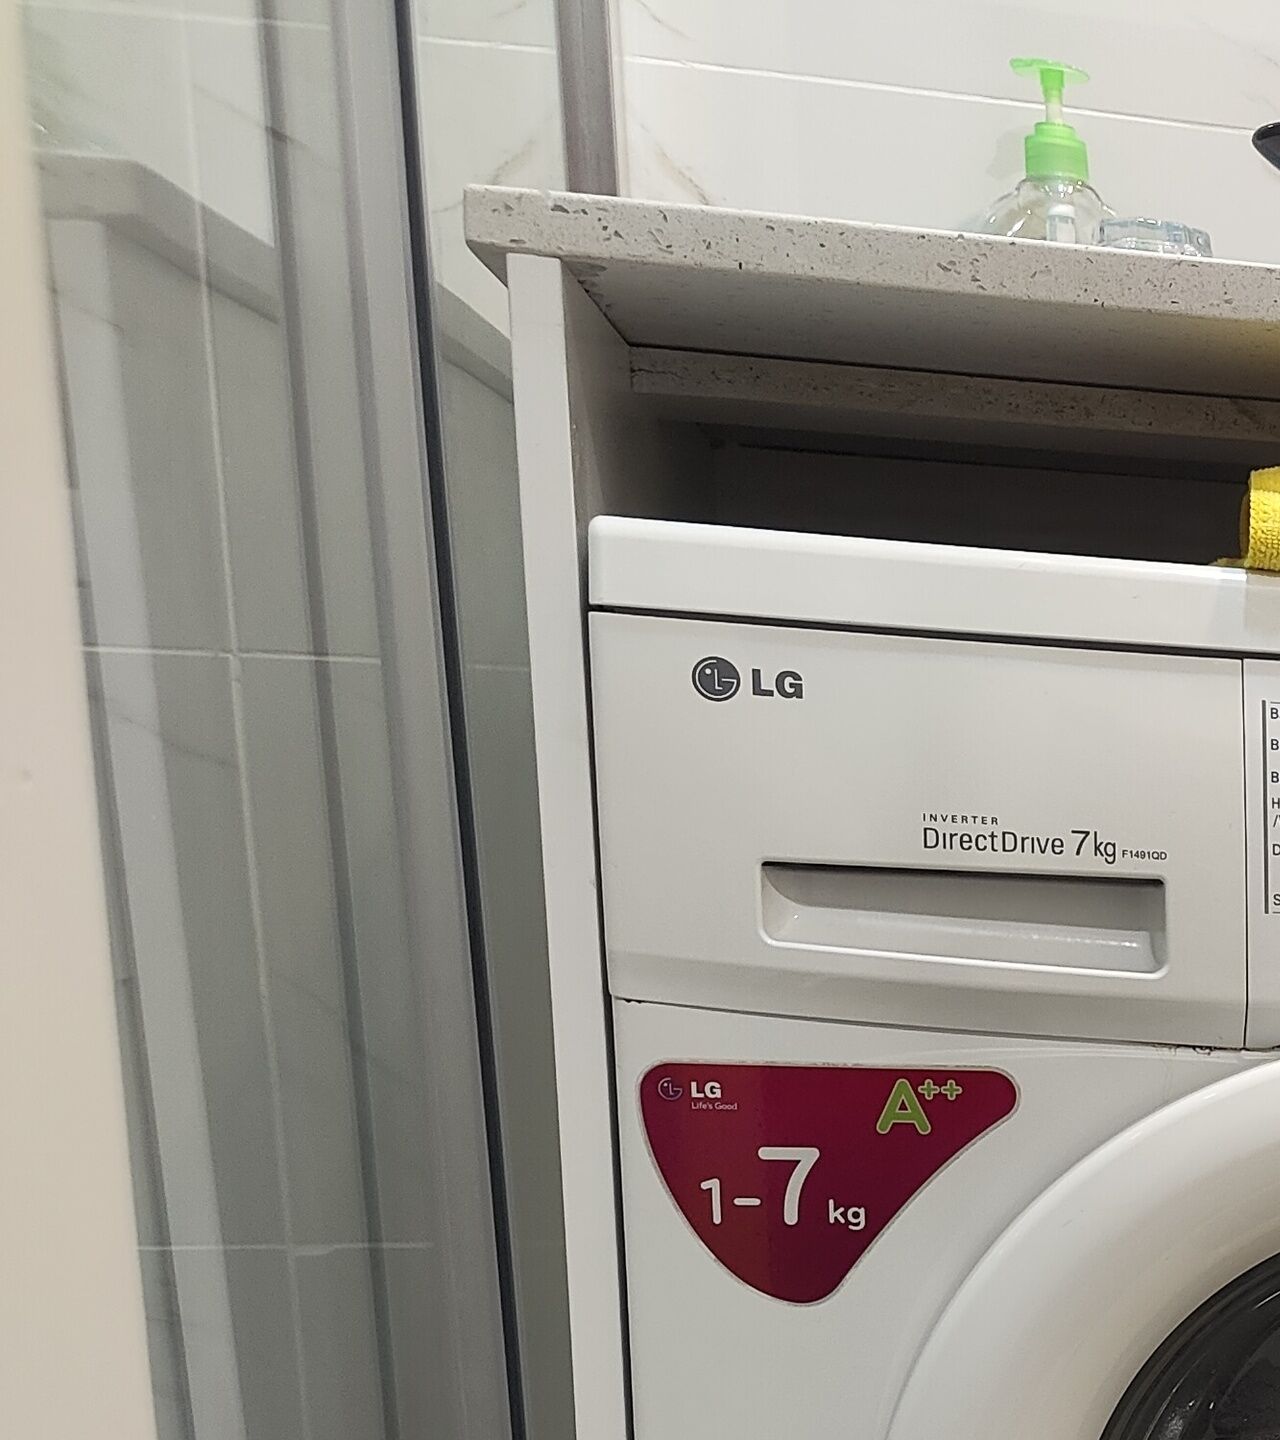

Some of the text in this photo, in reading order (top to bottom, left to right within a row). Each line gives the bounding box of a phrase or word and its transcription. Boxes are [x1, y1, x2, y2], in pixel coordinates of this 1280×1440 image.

[752, 668, 804, 700] LG
[922, 812, 1000, 826] INVERTER
[1121, 849, 1168, 862] F1491QD
[690, 1081, 722, 1099] LG
[691, 1101, 738, 1111] Life's Good
[876, 1078, 963, 1135] A++
[828, 1198, 866, 1231] kg
